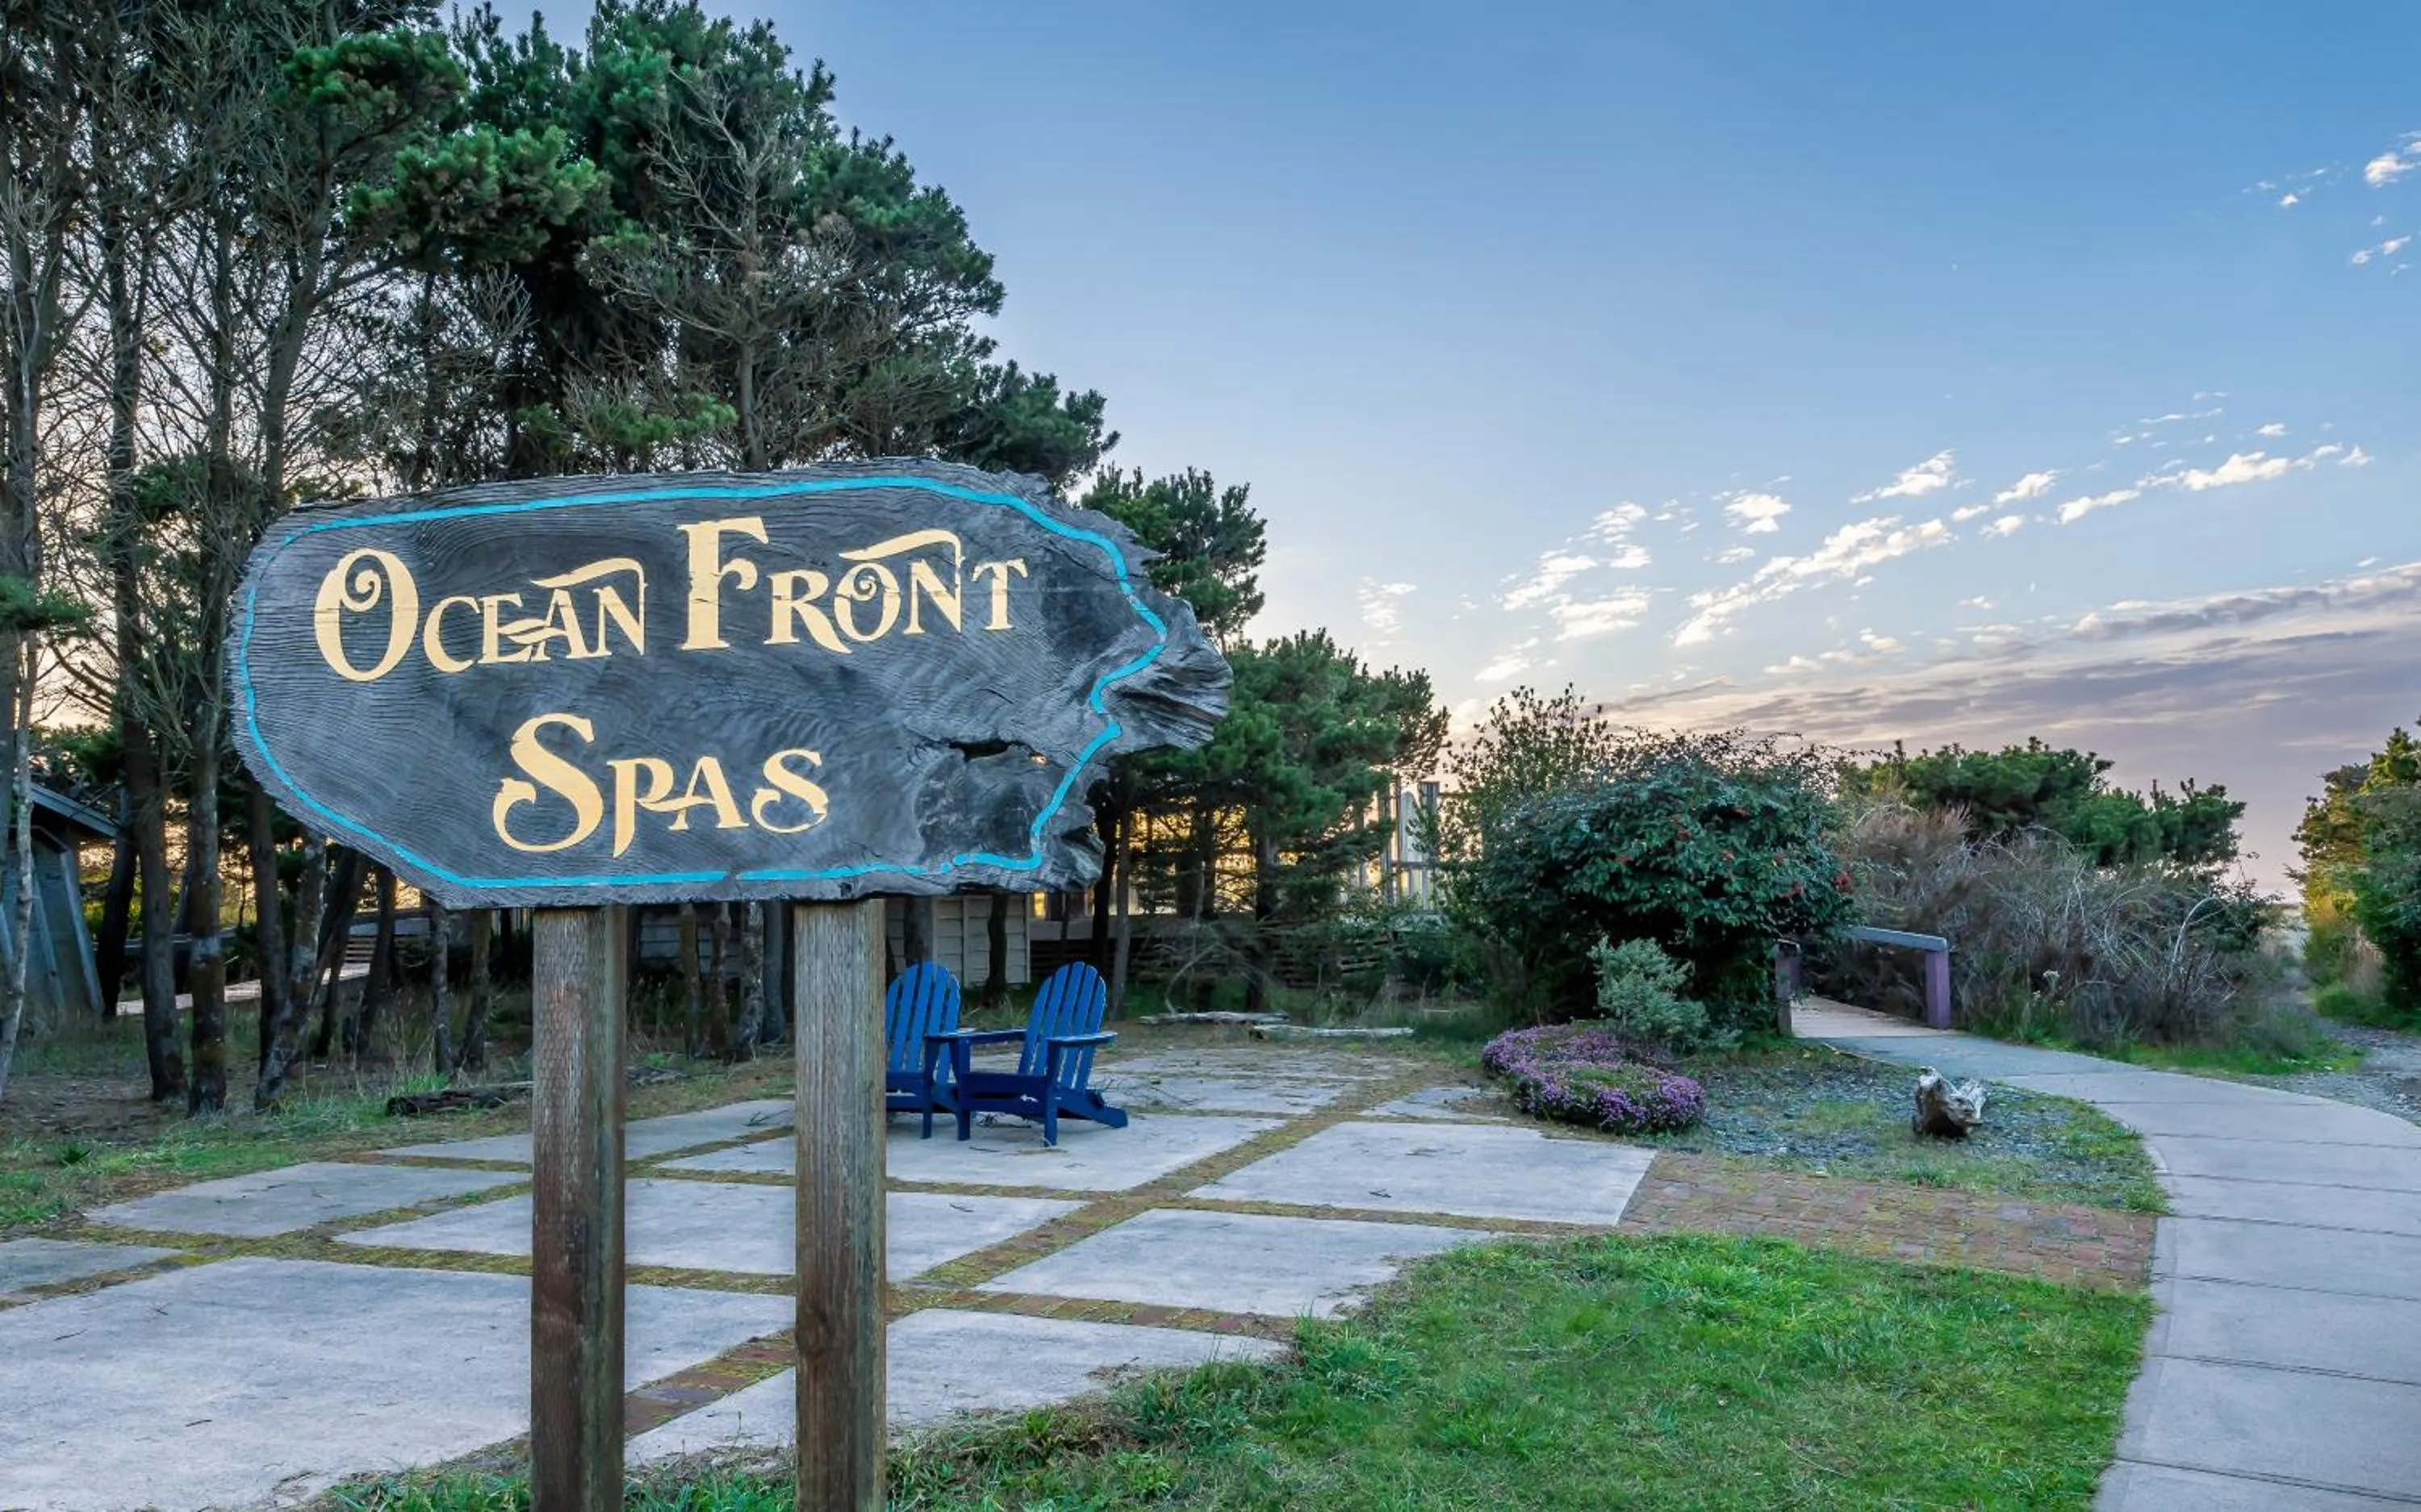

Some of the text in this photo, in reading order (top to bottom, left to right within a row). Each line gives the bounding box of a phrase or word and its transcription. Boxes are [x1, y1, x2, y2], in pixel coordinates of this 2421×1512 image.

[313, 516, 1029, 683] OCEAN FRONT
[492, 712, 830, 858] SPAS
